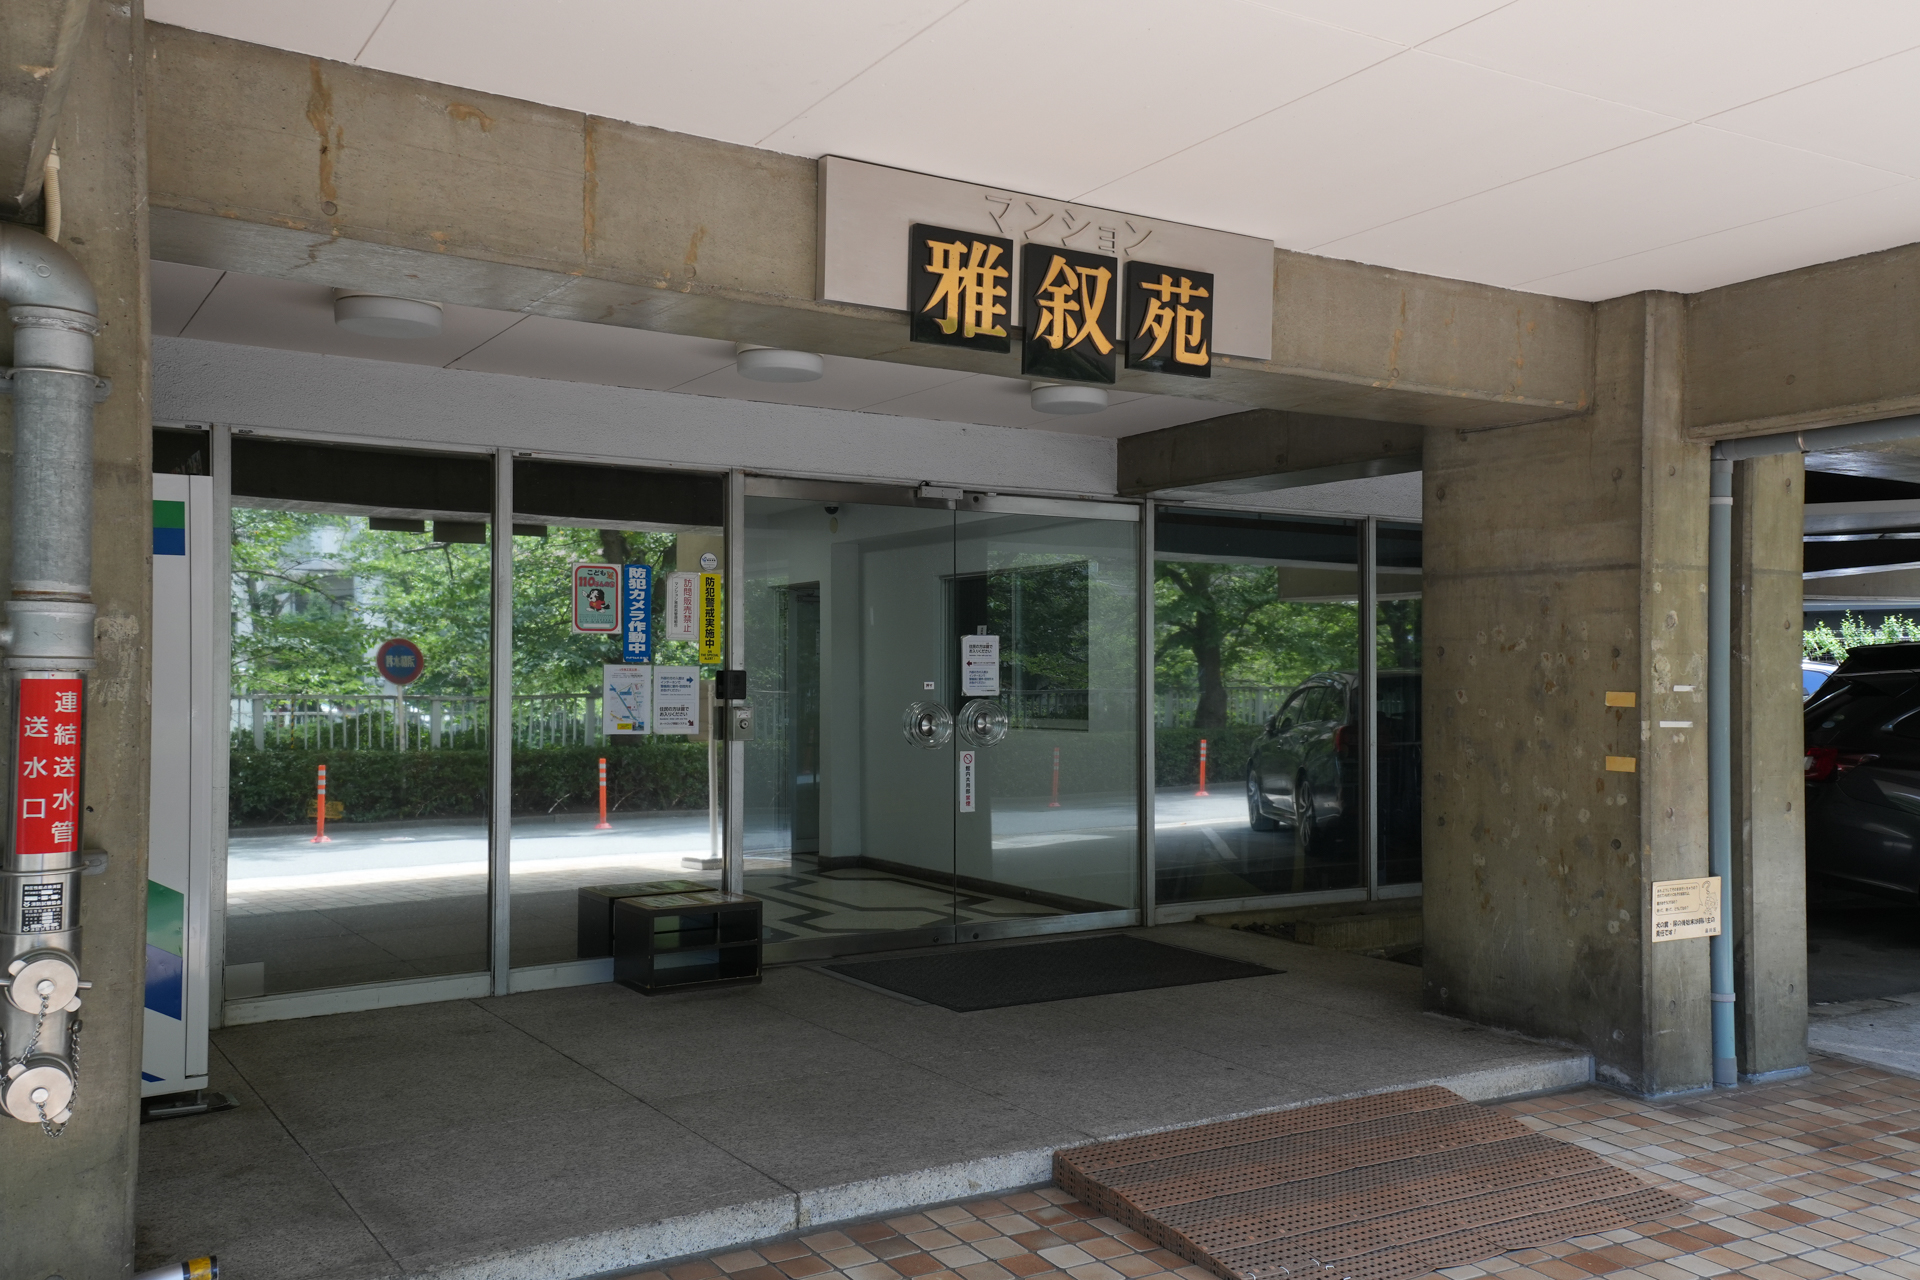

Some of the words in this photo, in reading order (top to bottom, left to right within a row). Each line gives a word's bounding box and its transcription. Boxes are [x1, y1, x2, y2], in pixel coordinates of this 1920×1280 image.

[985, 195, 1153, 256] マンション
[921, 239, 1210, 367] 雅叙苑
[628, 567, 647, 654] 防犯カメラ作動中
[683, 578, 692, 633] 訪問販売禁止
[704, 576, 715, 649] 防犯警戒実施中
[23, 716, 49, 819] 送水口
[51, 691, 78, 844] 連結送水管
